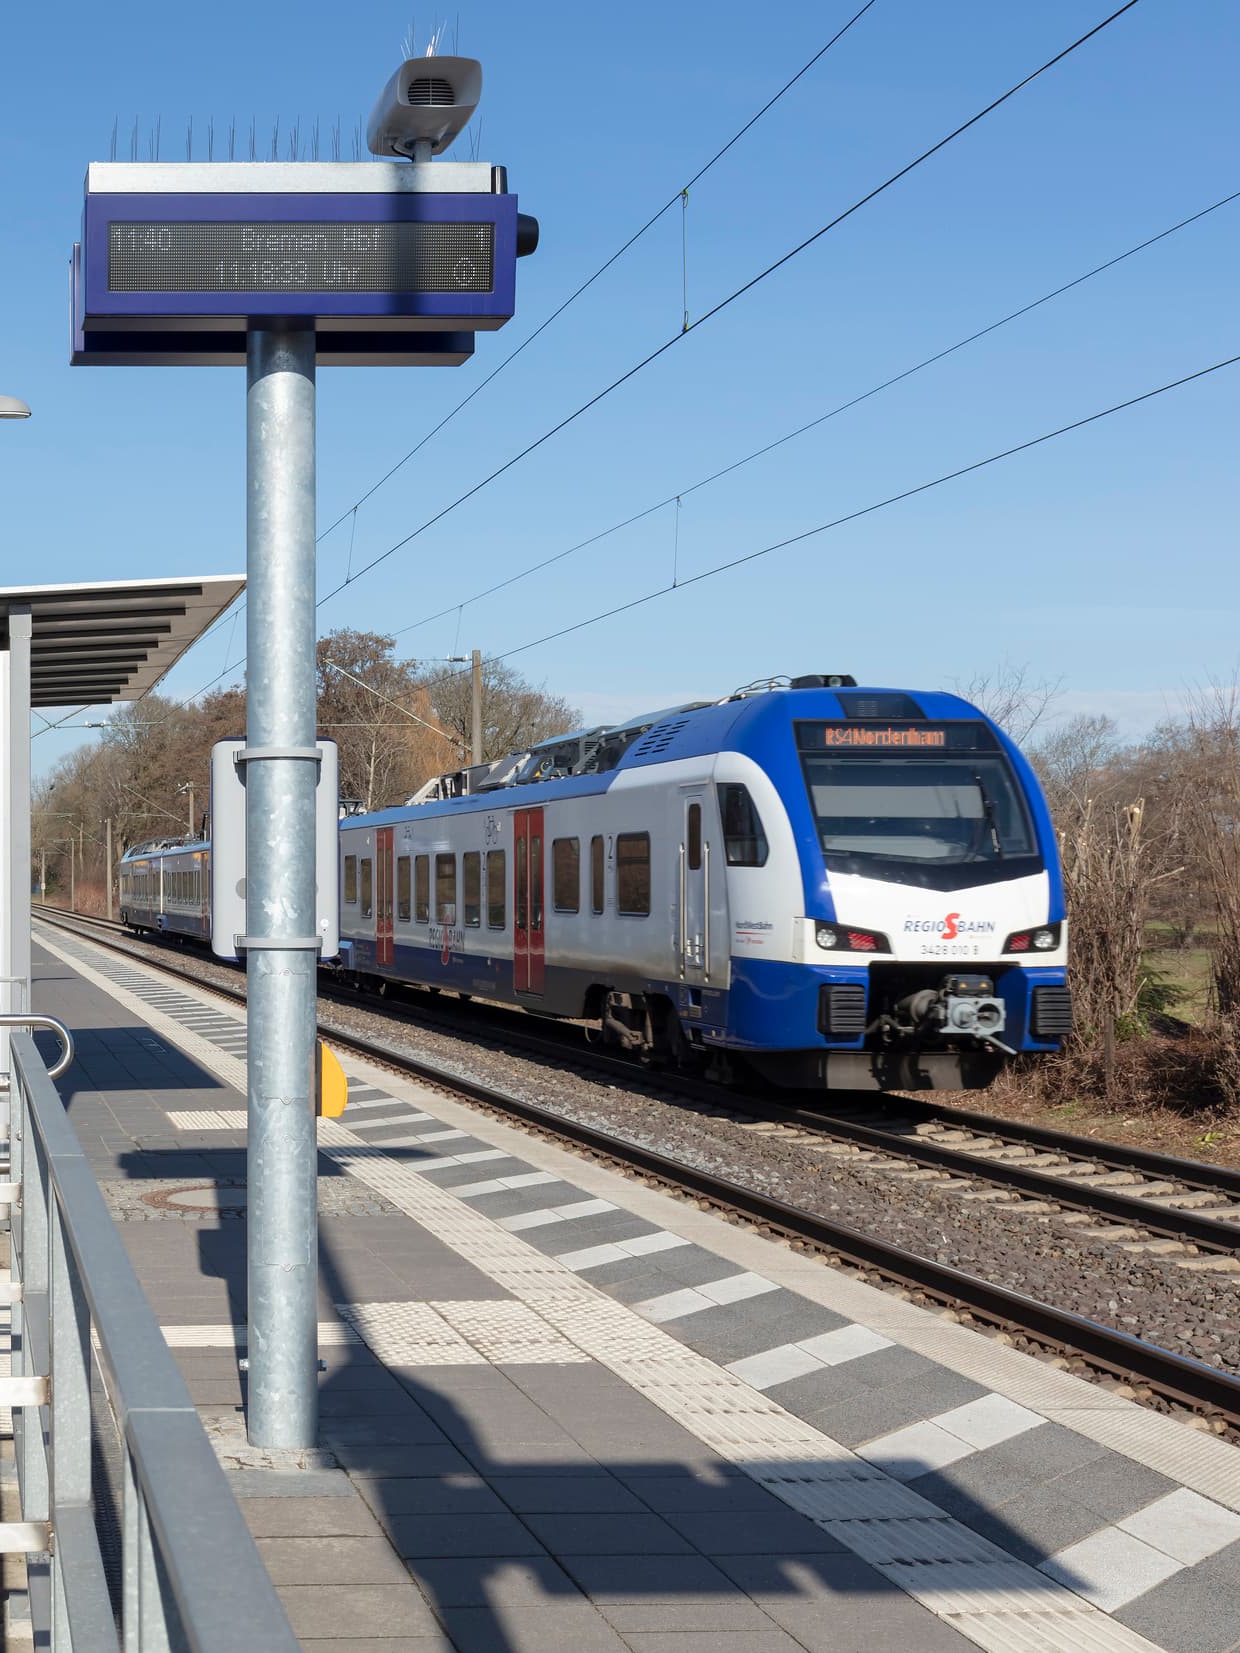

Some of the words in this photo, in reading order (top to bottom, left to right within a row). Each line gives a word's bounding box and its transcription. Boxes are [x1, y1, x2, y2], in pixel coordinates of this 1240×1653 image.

[113, 228, 171, 252] 11:40
[241, 228, 327, 252] Bremen
[343, 228, 380, 252] Hbf
[475, 227, 485, 252] 1
[215, 260, 308, 283] 11:18:33
[323, 260, 360, 283] Uhr
[825, 727, 853, 746] RS4
[853, 727, 946, 747] Nordenham
